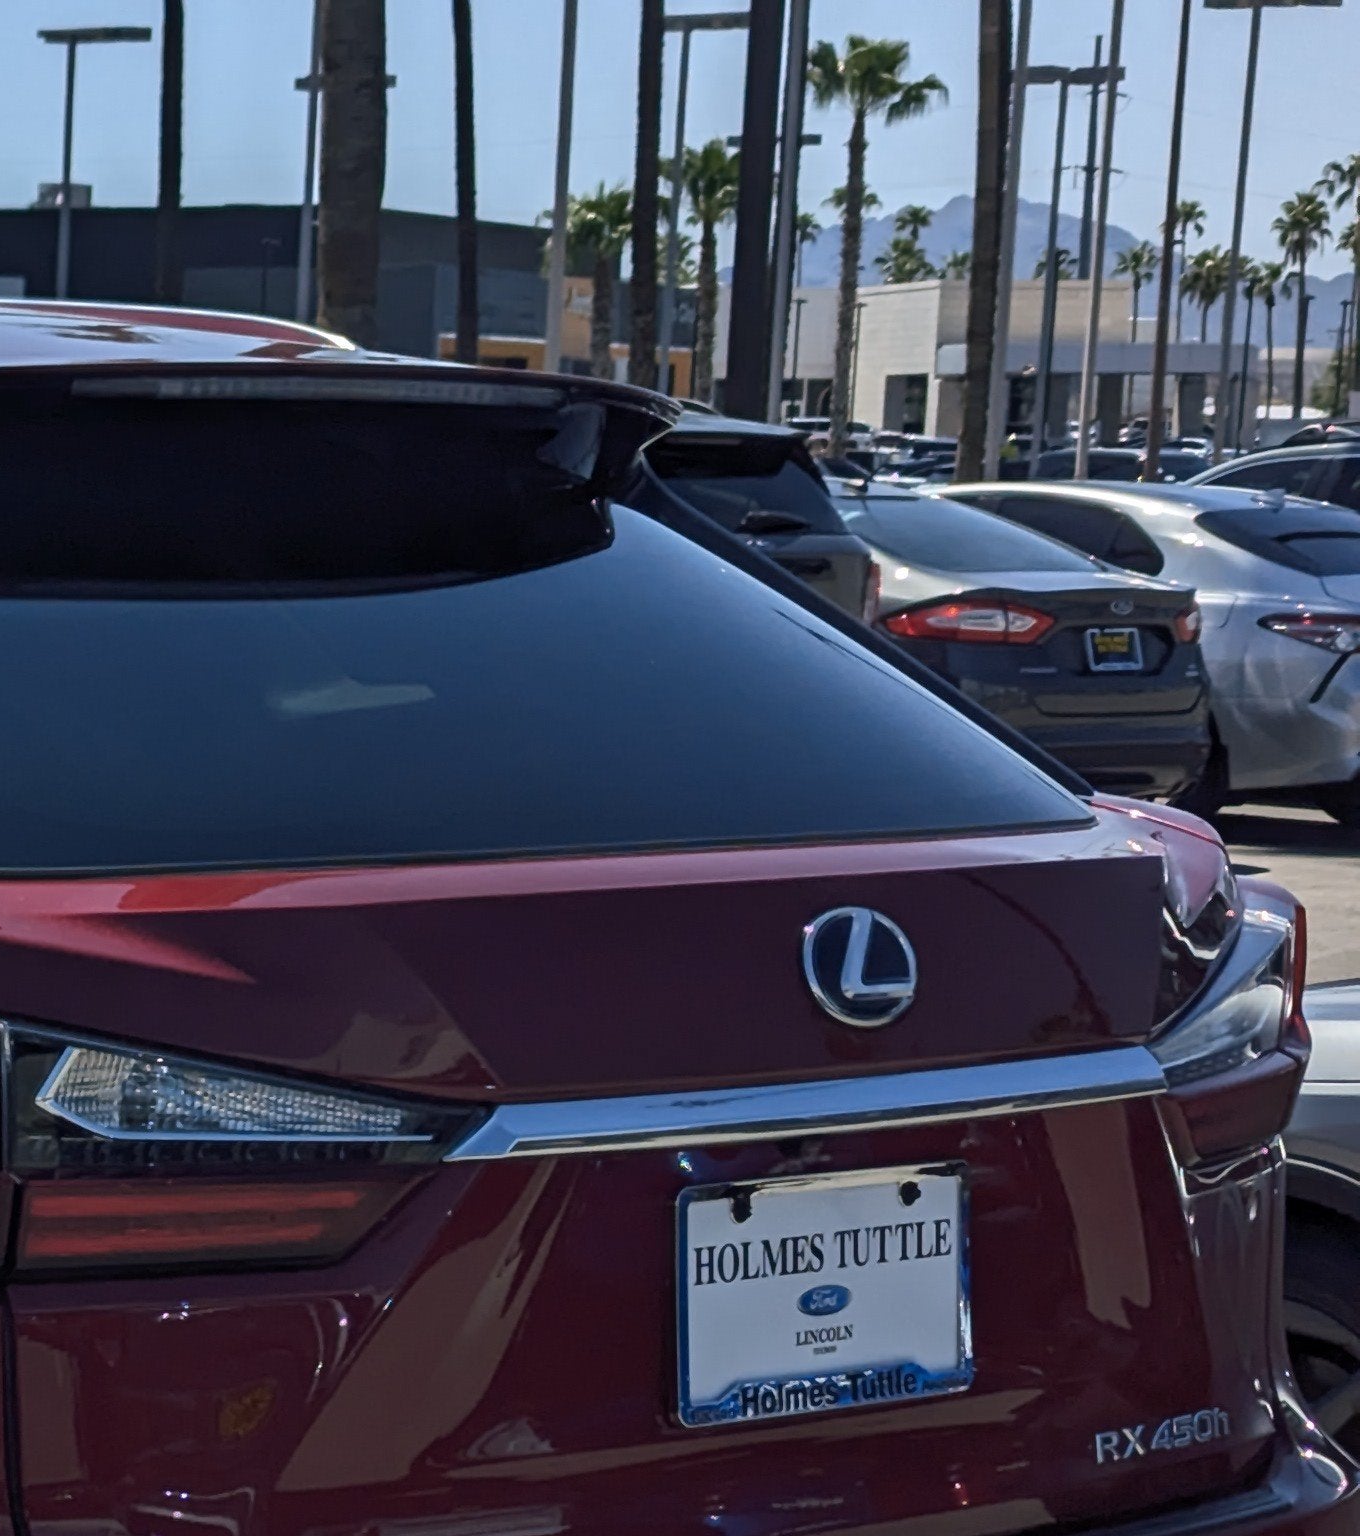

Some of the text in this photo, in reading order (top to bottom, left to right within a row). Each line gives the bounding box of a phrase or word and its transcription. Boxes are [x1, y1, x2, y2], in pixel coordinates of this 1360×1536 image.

[693, 1218, 952, 1286] HOLMES TUTTLE
[795, 1323, 854, 1347] LINCOLN
[741, 1378, 839, 1417] Holmes
[845, 1367, 918, 1402] Tuttle
[1095, 1406, 1230, 1464] RX 450h
